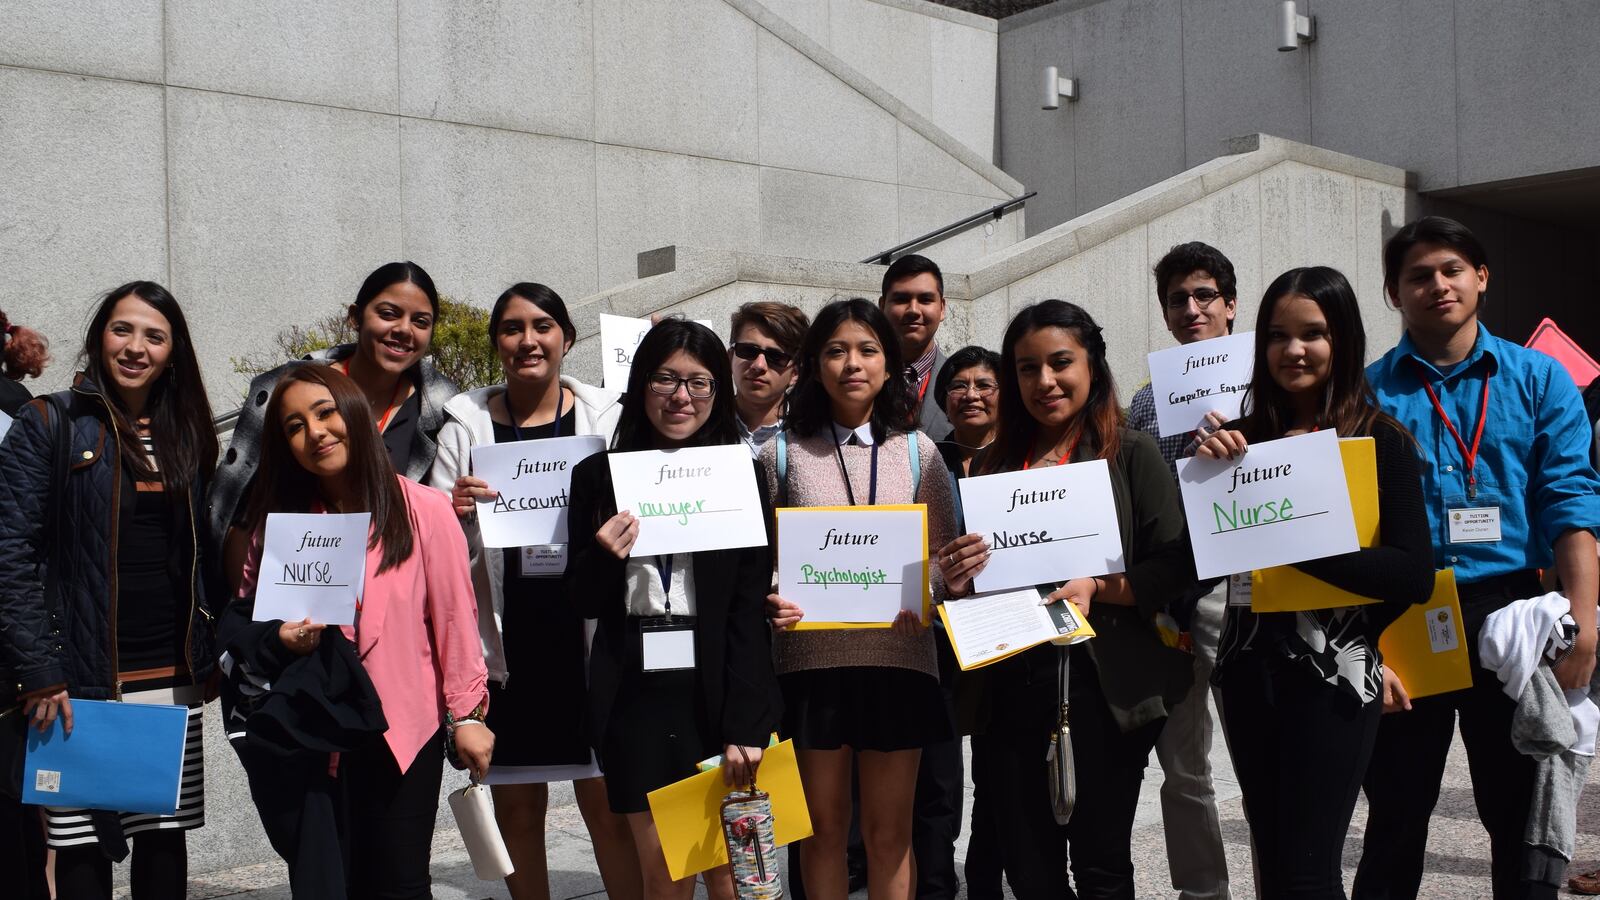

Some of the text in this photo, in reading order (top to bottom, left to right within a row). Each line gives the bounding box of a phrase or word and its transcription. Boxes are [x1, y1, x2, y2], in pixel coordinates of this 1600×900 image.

[1182, 353, 1229, 375] future
[512, 458, 567, 480] future
[654, 464, 712, 485] future
[1227, 463, 1292, 493] future
[493, 488, 568, 513] Account
[1007, 488, 1067, 512] future
[1213, 497, 1293, 533] Nurse
[296, 531, 342, 552] future
[819, 528, 879, 551] future
[992, 530, 1053, 550] Nurse
[800, 564, 887, 591] Psychologist
